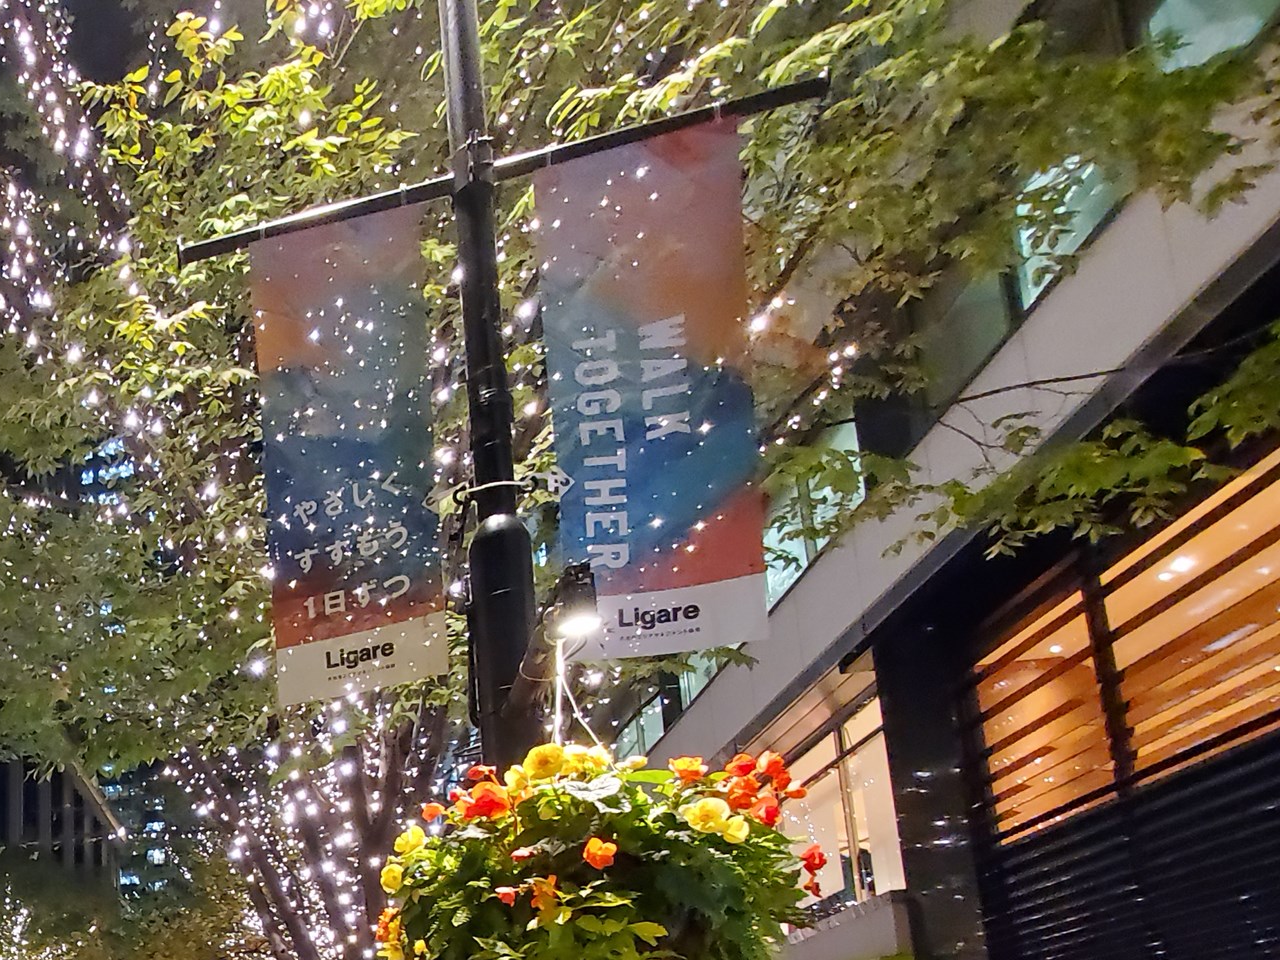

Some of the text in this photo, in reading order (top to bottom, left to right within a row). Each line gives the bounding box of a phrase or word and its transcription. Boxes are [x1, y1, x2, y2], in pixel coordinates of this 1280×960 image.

[637, 312, 691, 441] WALK
[572, 329, 630, 569] TOGETHER
[293, 472, 402, 525] やさしく
[294, 521, 408, 573] すすもう
[303, 575, 410, 619] 1日ずつ
[618, 604, 700, 629] Ligare
[325, 642, 394, 669] Ligare
